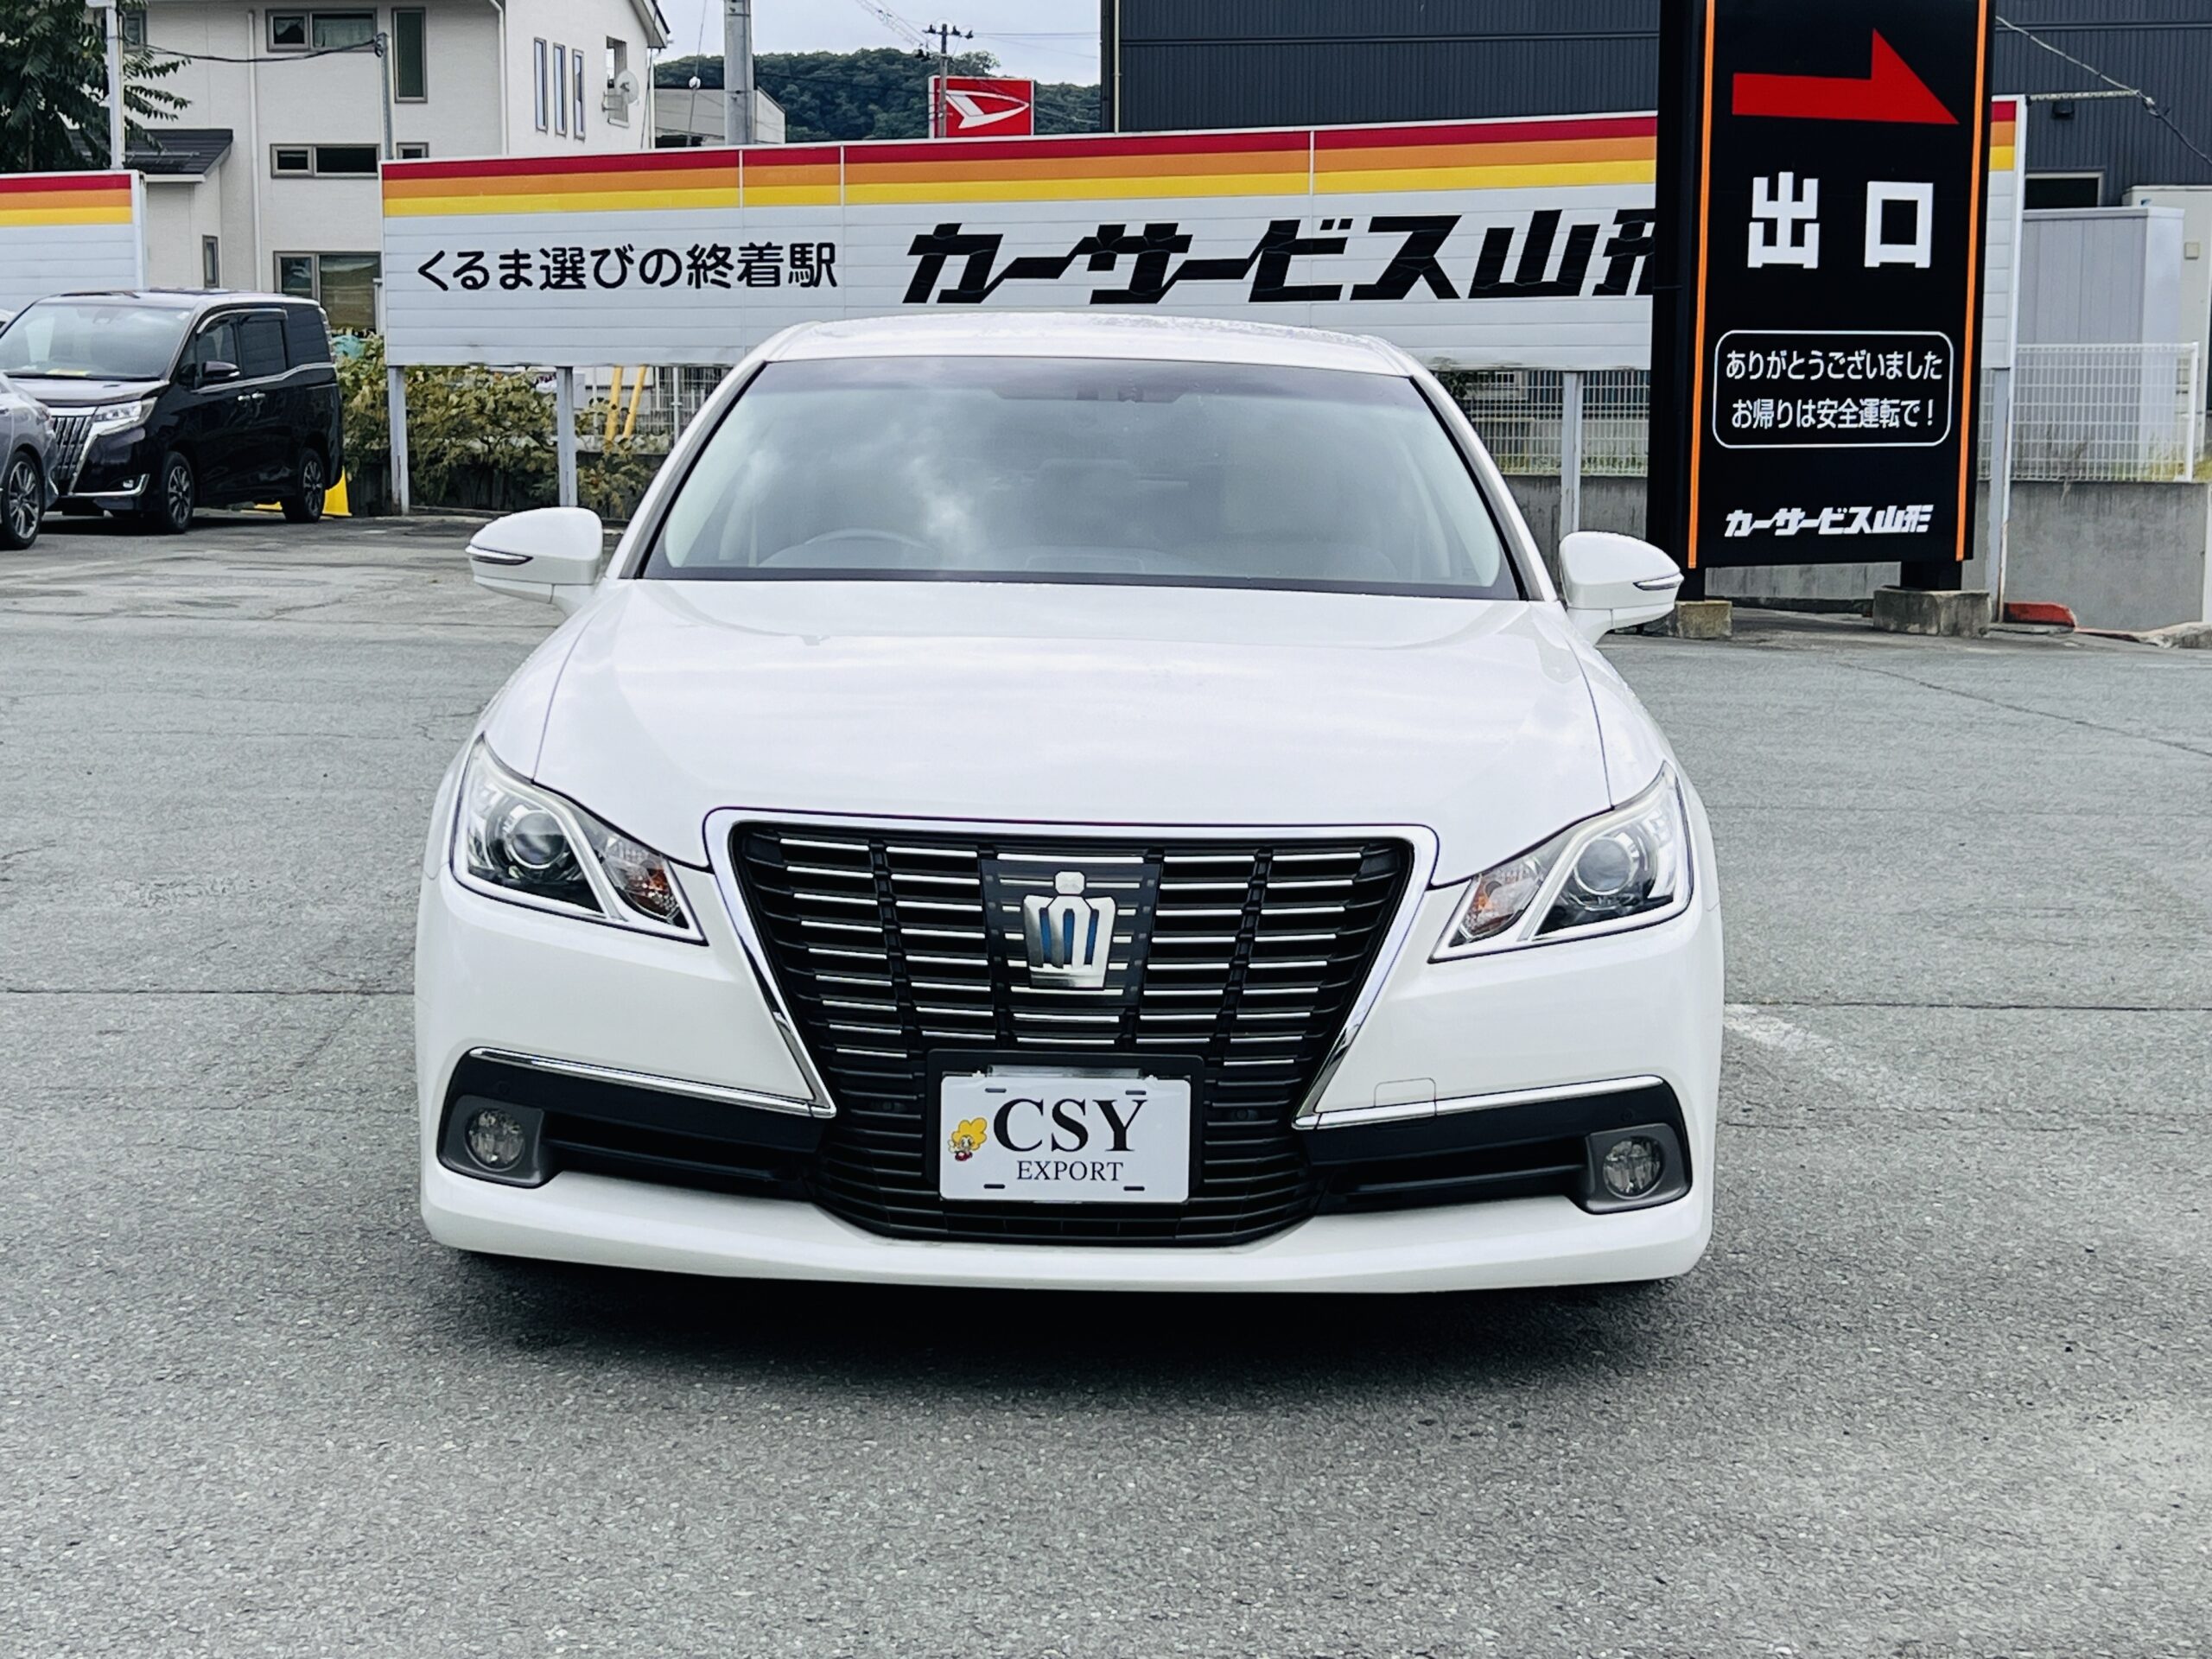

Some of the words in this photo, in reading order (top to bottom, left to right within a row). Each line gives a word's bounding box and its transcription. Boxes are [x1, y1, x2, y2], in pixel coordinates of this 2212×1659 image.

[1747, 171, 1934, 270] 出口
[416, 241, 838, 291] くるま選びの終着駅
[1726, 350, 1943, 380] ありがとうございました
[1732, 397, 1935, 429] お帰りは安全運転で！
[1724, 504, 1935, 537] カーサービス山形
[993, 1098, 1148, 1152] CSY
[1016, 1160, 1124, 1181] EXPORT
